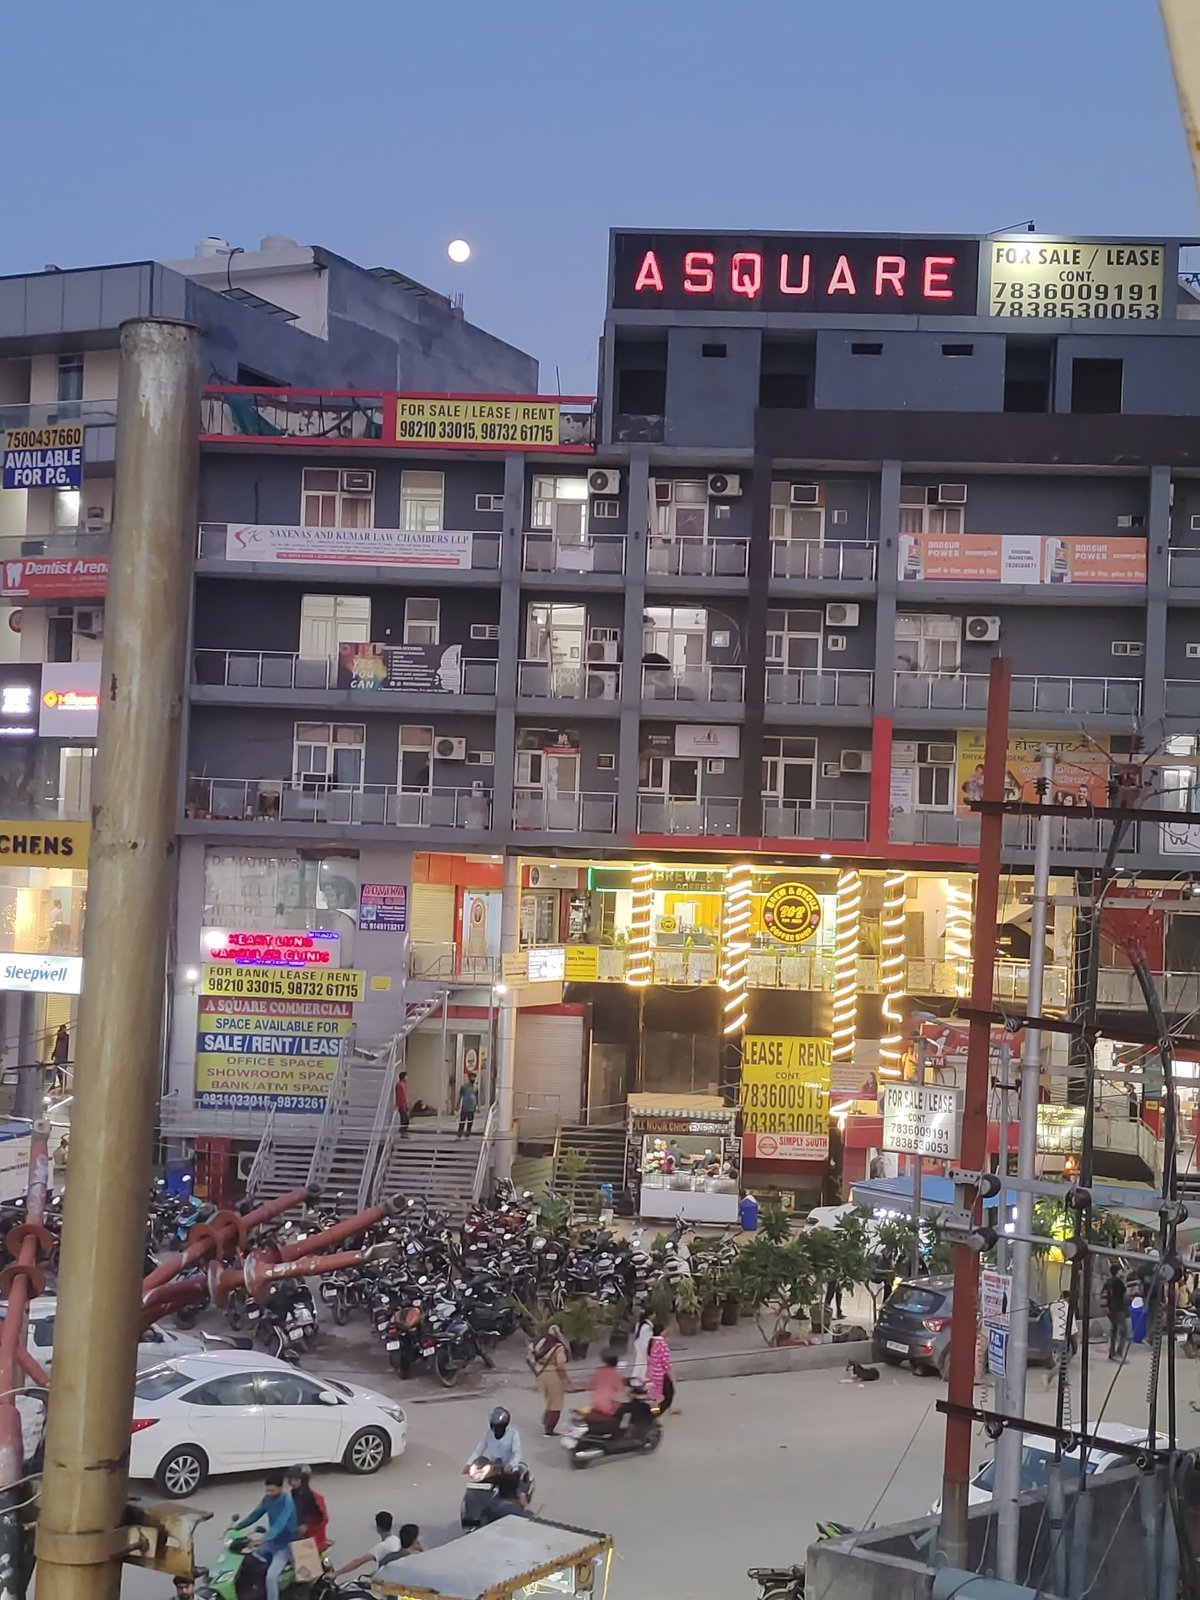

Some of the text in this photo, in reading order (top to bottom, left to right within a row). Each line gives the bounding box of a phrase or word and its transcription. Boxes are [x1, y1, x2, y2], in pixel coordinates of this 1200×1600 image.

[996, 248, 1160, 270] FOR SALE / LEASE
[1059, 271, 1095, 283] CONT.
[993, 282, 1157, 301] 7836009191
[992, 301, 1160, 320] 7838530053
[401, 403, 425, 417] FOR
[429, 404, 461, 418] SALE
[472, 405, 511, 420] LEASE
[522, 408, 555, 421] RENT
[7, 428, 81, 449] 7500437660
[400, 420, 553, 442] 98210 33015, 98732 61715
[5, 449, 81, 469] AVAILABLE
[14, 467, 70, 486] FOR P.G.
[269, 529, 469, 544] SAXENAS AND KUMAR LAW CHAMBERS LLP
[928, 549, 959, 557] POWER
[1075, 552, 1107, 560] POWER
[25, 561, 72, 575] Dentist
[351, 670, 375, 679] YOU
[350, 680, 375, 689] CAN
[655, 871, 697, 882] BREW
[770, 925, 795, 941] COFFEE
[284, 950, 329, 963] CLINIC
[4, 965, 68, 982] Sleepwell
[209, 967, 233, 977] FOR
[236, 967, 269, 978] BANK
[280, 970, 317, 981] LEASE
[327, 972, 358, 982] RENT
[208, 978, 358, 998] 98210 33015, 98732 61715
[205, 998, 349, 1016] A SQUARE COMMERCIAL
[216, 1018, 339, 1033] SPACE AVAILABLE FOR
[744, 1041, 783, 1066] LEASE
[227, 1056, 325, 1068] OFFICE SPACE
[207, 1068, 335, 1081] SHOWROOM SPAC
[775, 1072, 801, 1080] CONT.
[293, 1083, 330, 1093] SPAC
[888, 1089, 903, 1108] FOR
[904, 1090, 923, 1110] SALE
[929, 1093, 953, 1114] LEASE
[908, 1113, 927, 1124] CONT.
[890, 1122, 949, 1140] 7836009191
[779, 1136, 828, 1148] SIMPLY SOUTH
[890, 1136, 949, 1154] 7838530053
